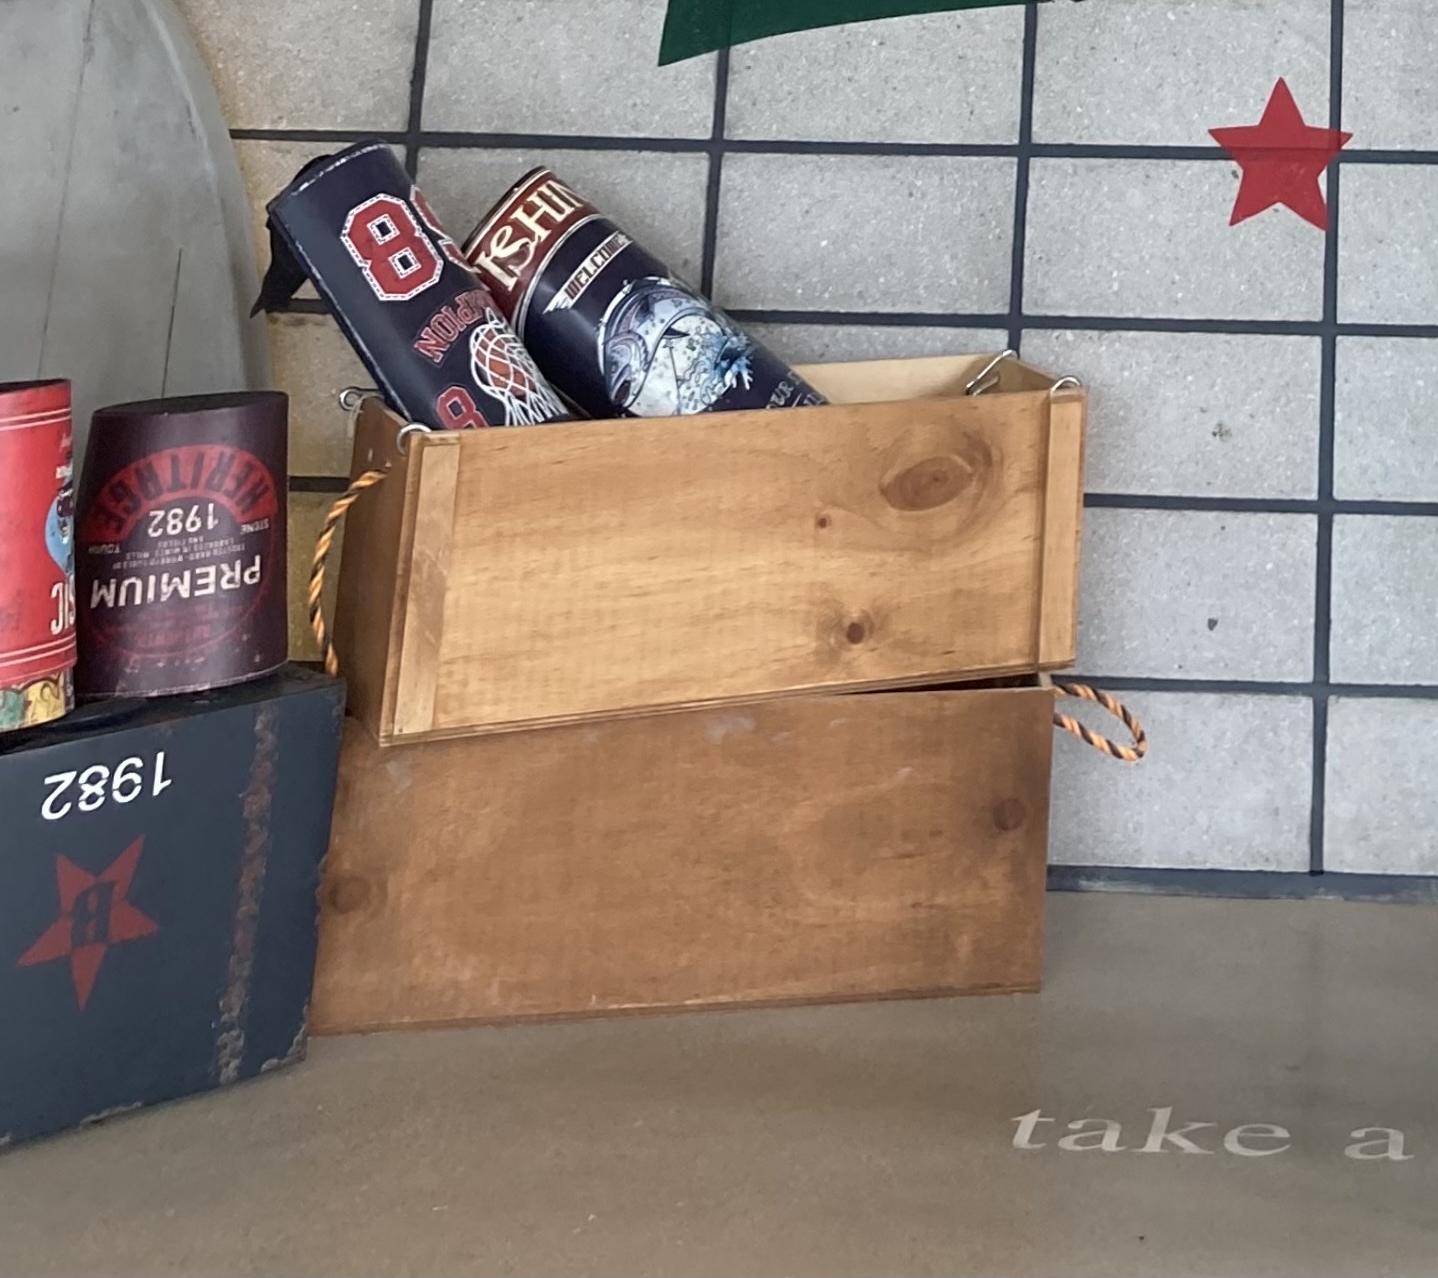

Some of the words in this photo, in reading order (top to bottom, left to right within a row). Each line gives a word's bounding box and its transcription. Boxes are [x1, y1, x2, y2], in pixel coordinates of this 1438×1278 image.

[97, 450, 270, 531] HERITAGE
[147, 503, 219, 537] 1982
[90, 554, 262, 608] PREMIUM
[41, 751, 172, 821] 1982
[1010, 1104, 1292, 1159] take
[1344, 1126, 1414, 1162] a
